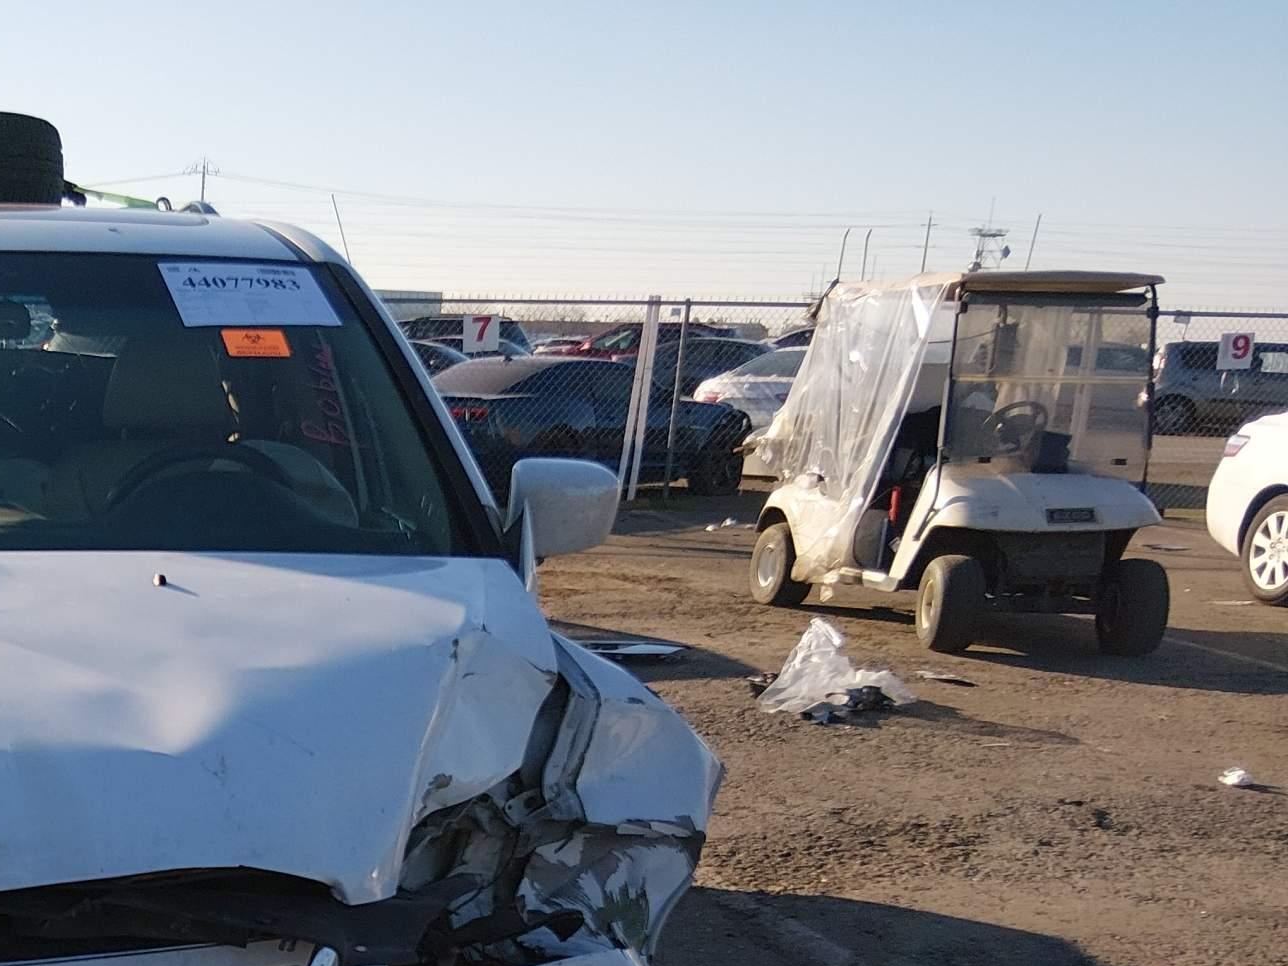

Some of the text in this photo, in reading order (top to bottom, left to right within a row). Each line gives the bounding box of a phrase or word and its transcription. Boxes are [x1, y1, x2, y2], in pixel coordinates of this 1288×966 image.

[182, 276, 301, 291] 44077983
[472, 316, 492, 342] 7
[1232, 335, 1250, 359] 9
